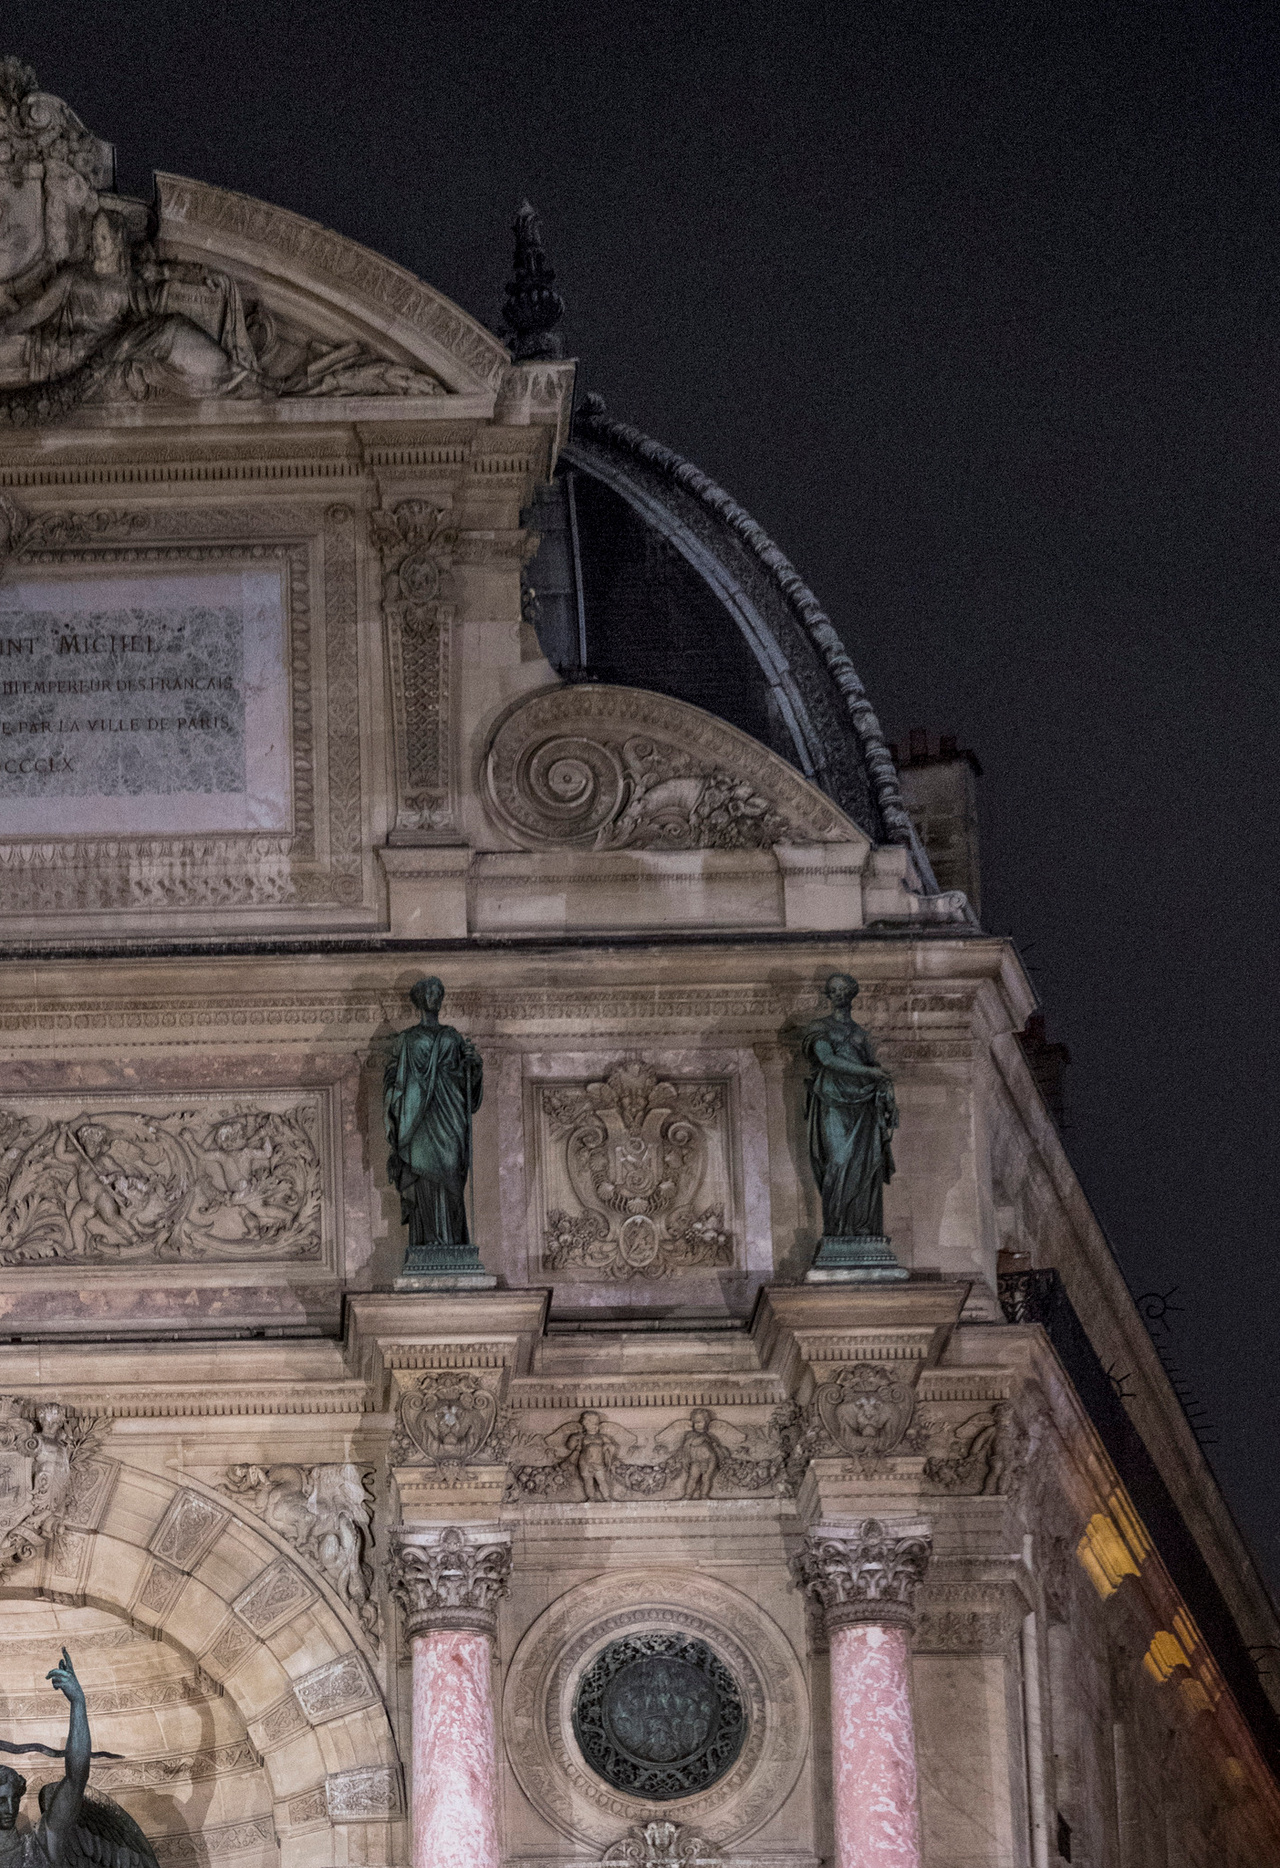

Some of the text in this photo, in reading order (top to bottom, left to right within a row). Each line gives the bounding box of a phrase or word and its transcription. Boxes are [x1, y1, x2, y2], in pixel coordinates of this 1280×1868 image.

[58, 634, 160, 655] MICHEL
[22, 679, 110, 695] EMPEREUR
[116, 677, 146, 692] DES
[19, 720, 51, 734] PAR
[59, 719, 80, 733] LA
[87, 718, 141, 732] VILLE
[147, 717, 167, 731] DE
[177, 716, 229, 731] PARIS
